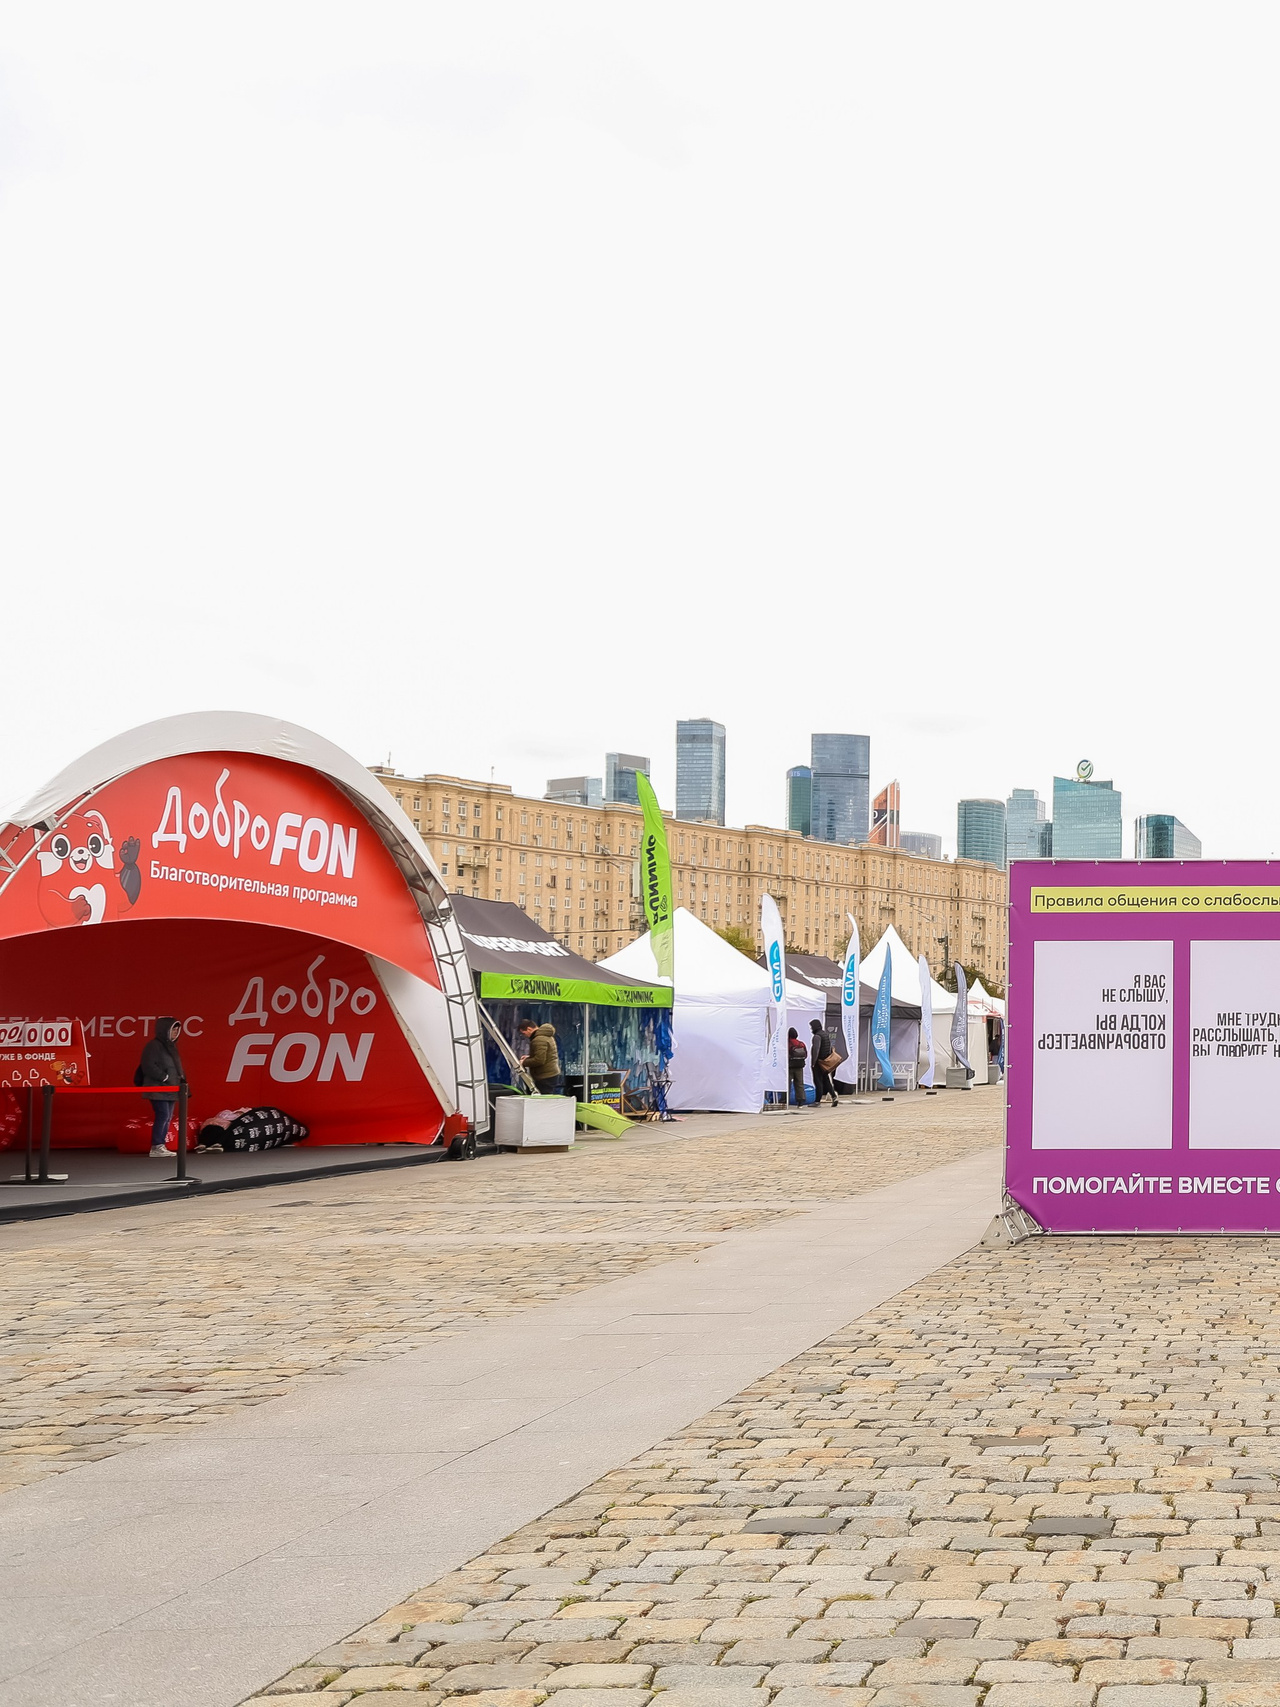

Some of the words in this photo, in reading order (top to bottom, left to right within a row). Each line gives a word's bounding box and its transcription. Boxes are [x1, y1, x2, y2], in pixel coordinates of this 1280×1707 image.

[150, 860, 290, 898] Благотворительная
[292, 885, 358, 907] программа
[1034, 894, 1103, 909] Правила
[1107, 893, 1177, 908] общения
[1181, 896, 1200, 906] со
[1133, 974, 1141, 988] Я
[1144, 974, 1166, 988] ВАС
[228, 954, 377, 1027] Добро
[1102, 988, 1117, 1002] НЕ
[1119, 988, 1169, 1004] СЛЫШУ,
[183, 1015, 204, 1037] С
[1217, 1012, 1242, 1026] МНЕ
[1193, 1028, 1278, 1043] РАССЛЫШАТЬ,
[24, 1052, 56, 1061] ФОНДЕ
[225, 1032, 375, 1083] FON
[1192, 1044, 1210, 1057] ВЫ
[1032, 1172, 1173, 1194] ПОМОГАЙТЕ
[1178, 1176, 1271, 1194] ВМЕСТЕ
